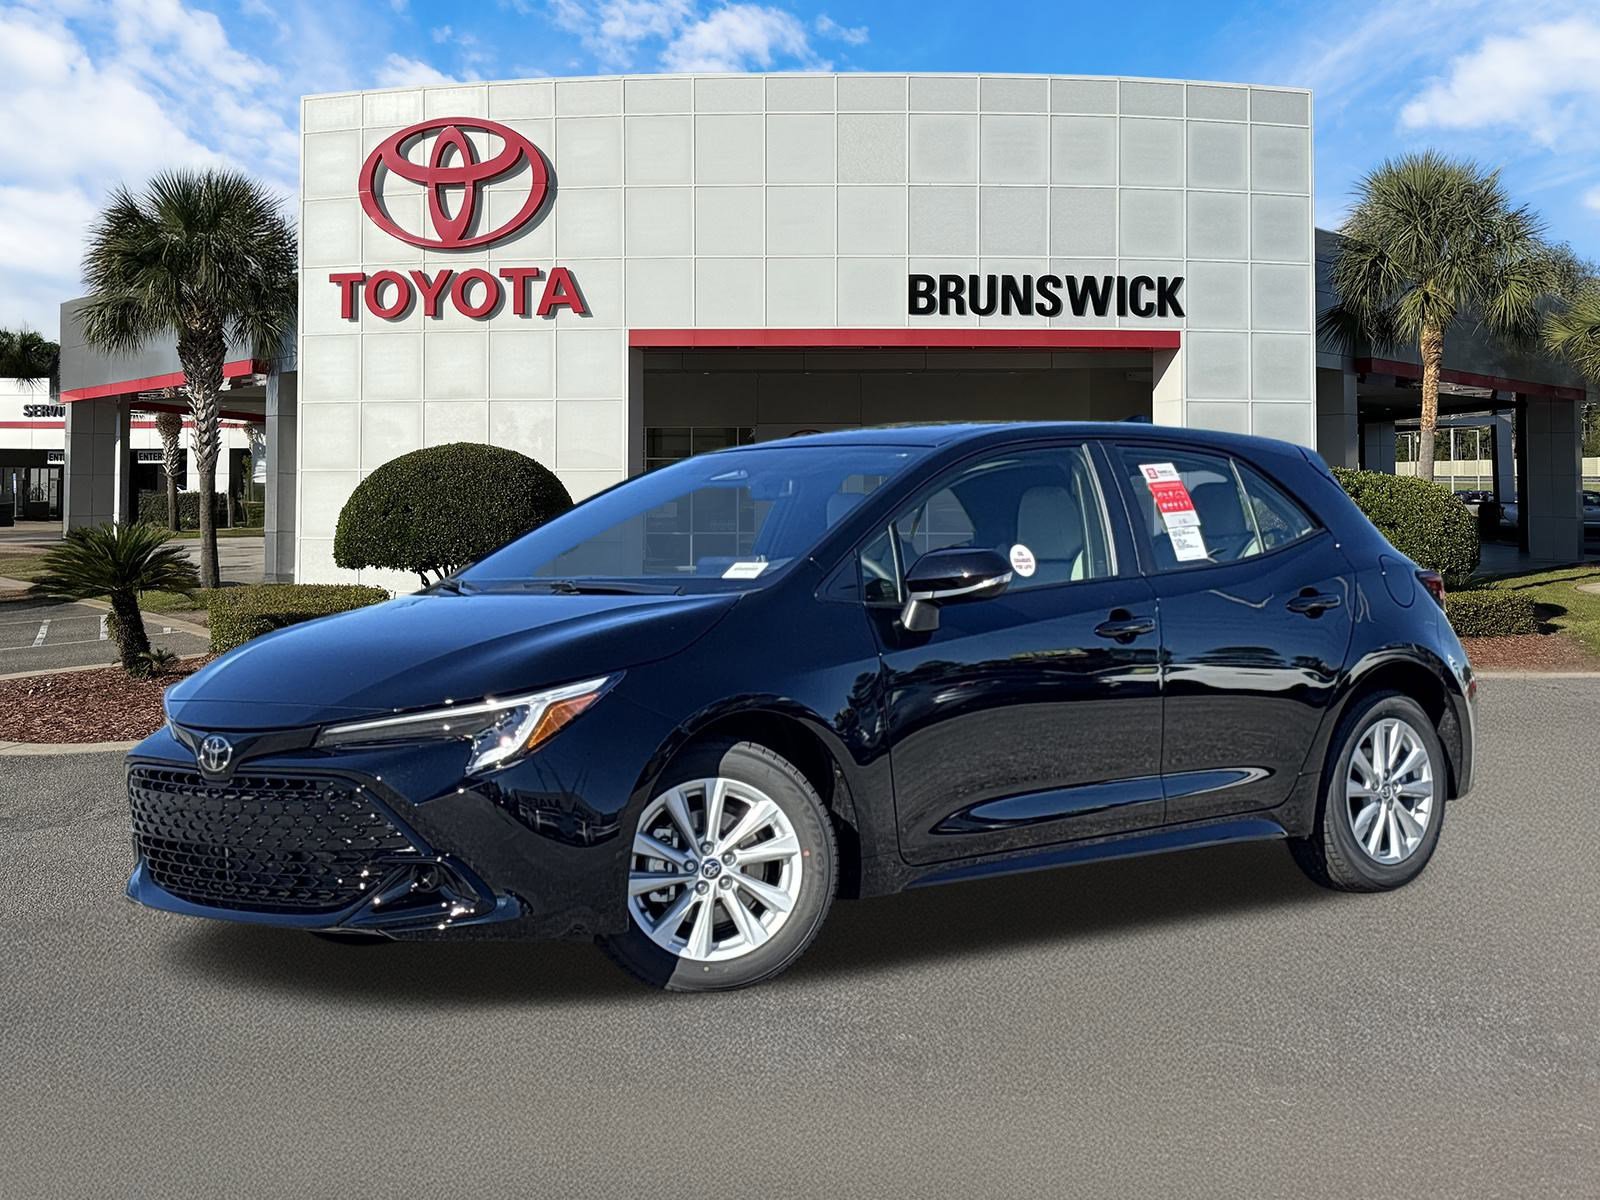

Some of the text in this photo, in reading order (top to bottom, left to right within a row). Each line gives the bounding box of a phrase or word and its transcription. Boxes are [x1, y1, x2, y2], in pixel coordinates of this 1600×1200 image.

[329, 266, 588, 319] TOYOTA
[908, 274, 1185, 317] BRUNSWICK
[23, 404, 65, 417] SERVI
[48, 452, 65, 461] ENT
[138, 452, 163, 461] ENTER
